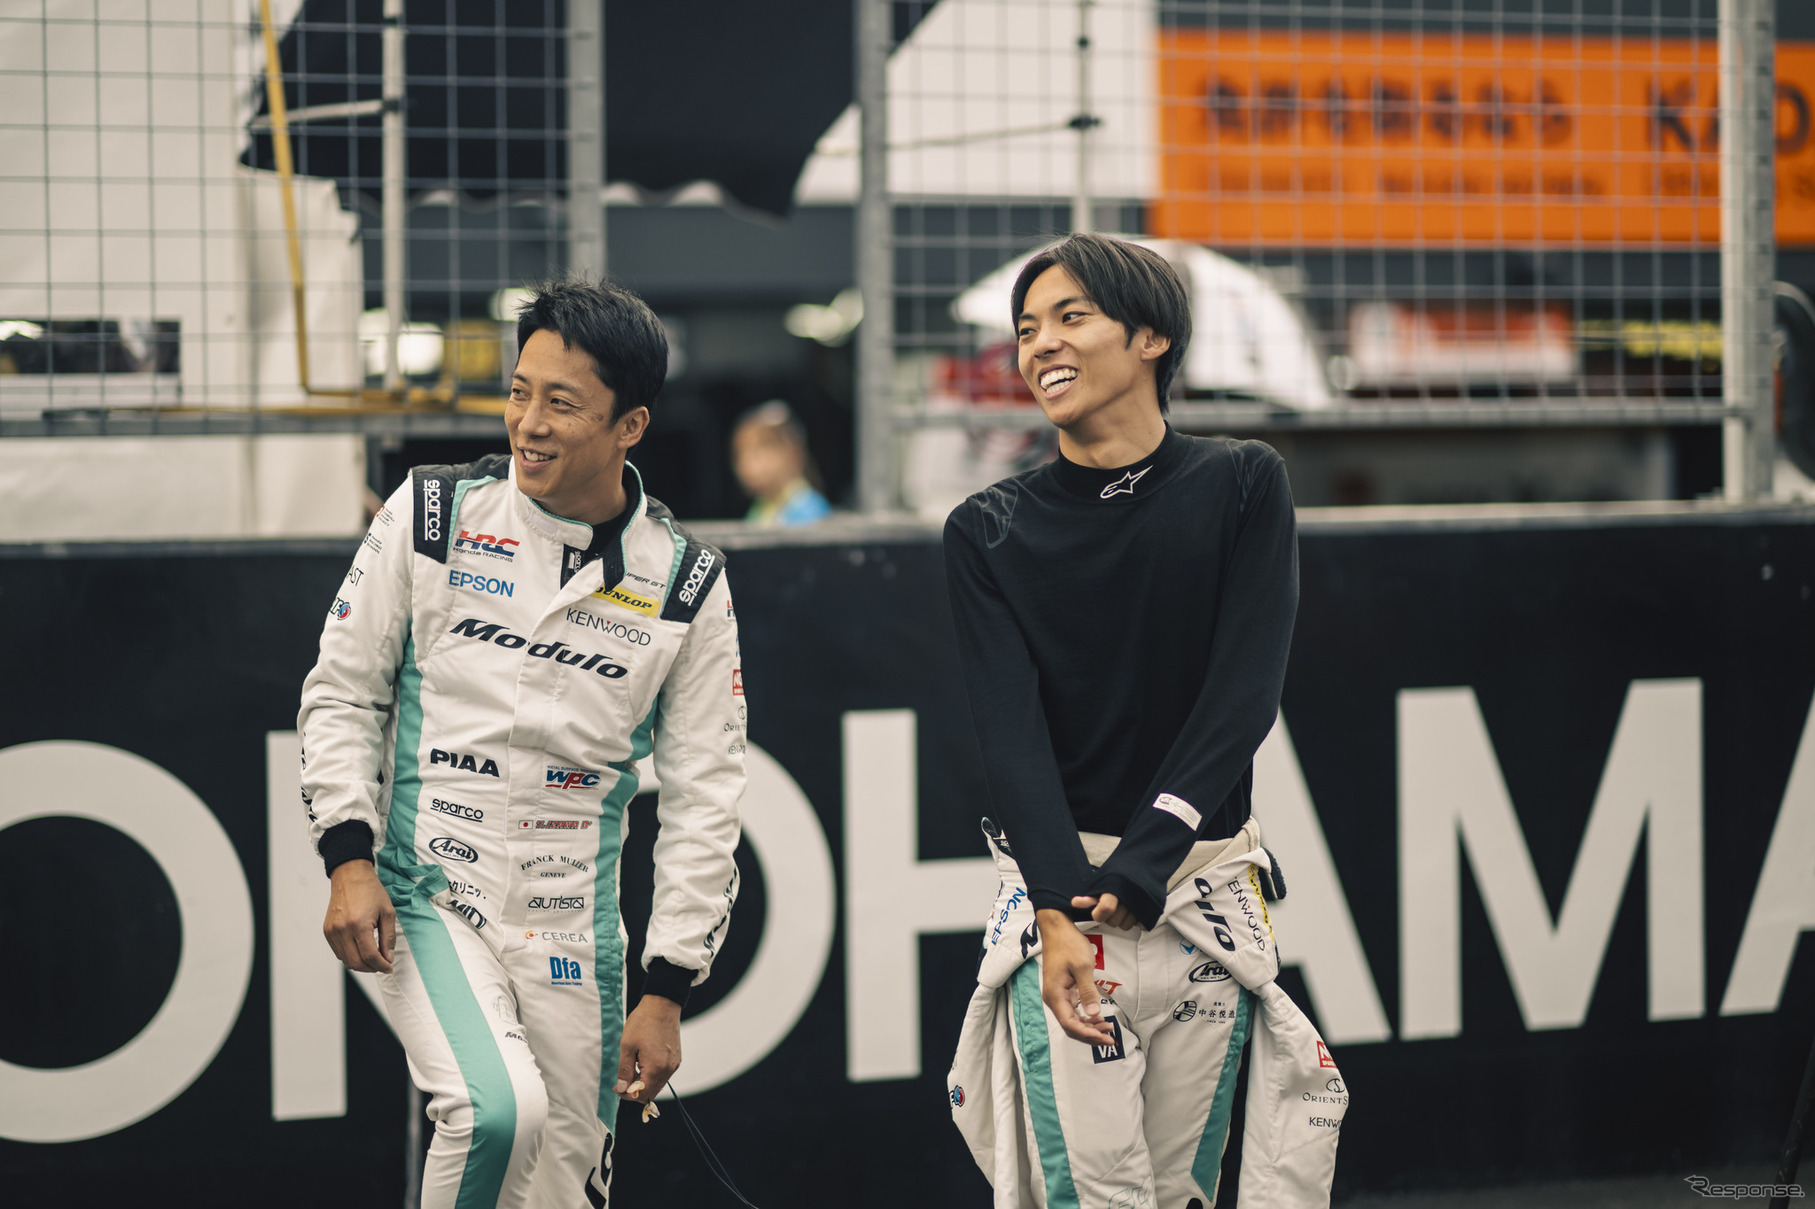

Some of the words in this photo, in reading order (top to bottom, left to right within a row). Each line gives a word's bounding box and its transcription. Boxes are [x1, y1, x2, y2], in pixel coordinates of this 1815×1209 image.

[424, 479, 441, 541] sparco
[453, 547, 481, 556] Honda
[482, 551, 513, 562] RACING
[455, 530, 520, 557] HRC
[448, 569, 514, 597] EPSON
[626, 572, 650, 584] PER
[678, 549, 715, 606] sparco
[566, 608, 651, 646] KENWOOD
[450, 618, 628, 679] Modulo
[430, 748, 500, 778] PIAA
[430, 799, 484, 821] sparco
[432, 840, 472, 859] Arai
[521, 855, 555, 871] FRANCK
[991, 887, 1027, 946] EPSON
[1227, 877, 1265, 951] ENWOOD
[542, 931, 588, 943] CEREA
[549, 956, 582, 980] Dfa
